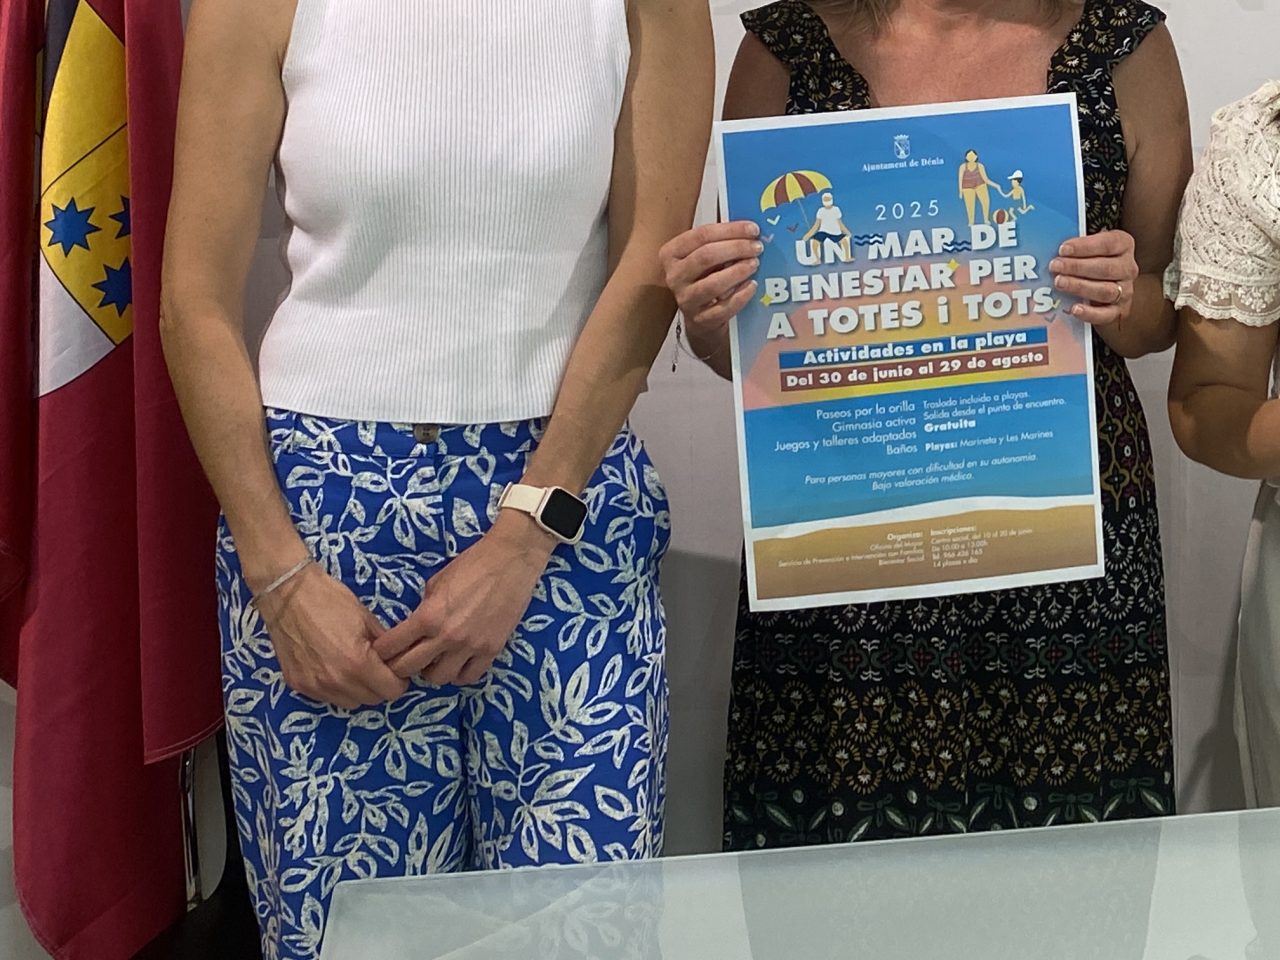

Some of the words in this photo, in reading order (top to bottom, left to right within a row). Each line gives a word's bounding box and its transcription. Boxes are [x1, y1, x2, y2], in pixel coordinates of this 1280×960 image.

[862, 160, 907, 172] Ajuntament
[908, 158, 919, 167] de
[919, 156, 944, 166] Dénia
[874, 198, 939, 221] 2025
[794, 234, 854, 266] UN
[867, 226, 954, 260] MAR
[969, 220, 1017, 250] DE
[765, 262, 953, 302] BENESTAR
[968, 254, 1037, 285] PER
[765, 311, 795, 339] A
[807, 299, 922, 334] TOTES
[936, 295, 948, 323] i
[961, 286, 1053, 319] TOTS
[803, 342, 913, 364] Actividades
[920, 341, 944, 354] en
[949, 335, 968, 350] la
[974, 332, 1027, 351] playa
[785, 372, 813, 387] Del
[818, 370, 842, 384] 30
[846, 368, 867, 382] de
[872, 364, 913, 382] junio
[917, 360, 934, 375] al
[938, 358, 962, 373] 29
[966, 355, 987, 369] de
[991, 351, 1044, 368] agosto
[815, 408, 852, 420] Paseos
[853, 406, 873, 419] por
[874, 402, 886, 415] la
[887, 399, 915, 414] orilla
[831, 420, 883, 433] Gimnasia
[884, 416, 916, 428] activa
[923, 418, 976, 432] Gratuita
[773, 440, 810, 453] Juegos
[811, 439, 820, 451] y
[821, 434, 859, 447] talleres
[861, 429, 917, 444] adaptados
[885, 443, 918, 455] Baños
